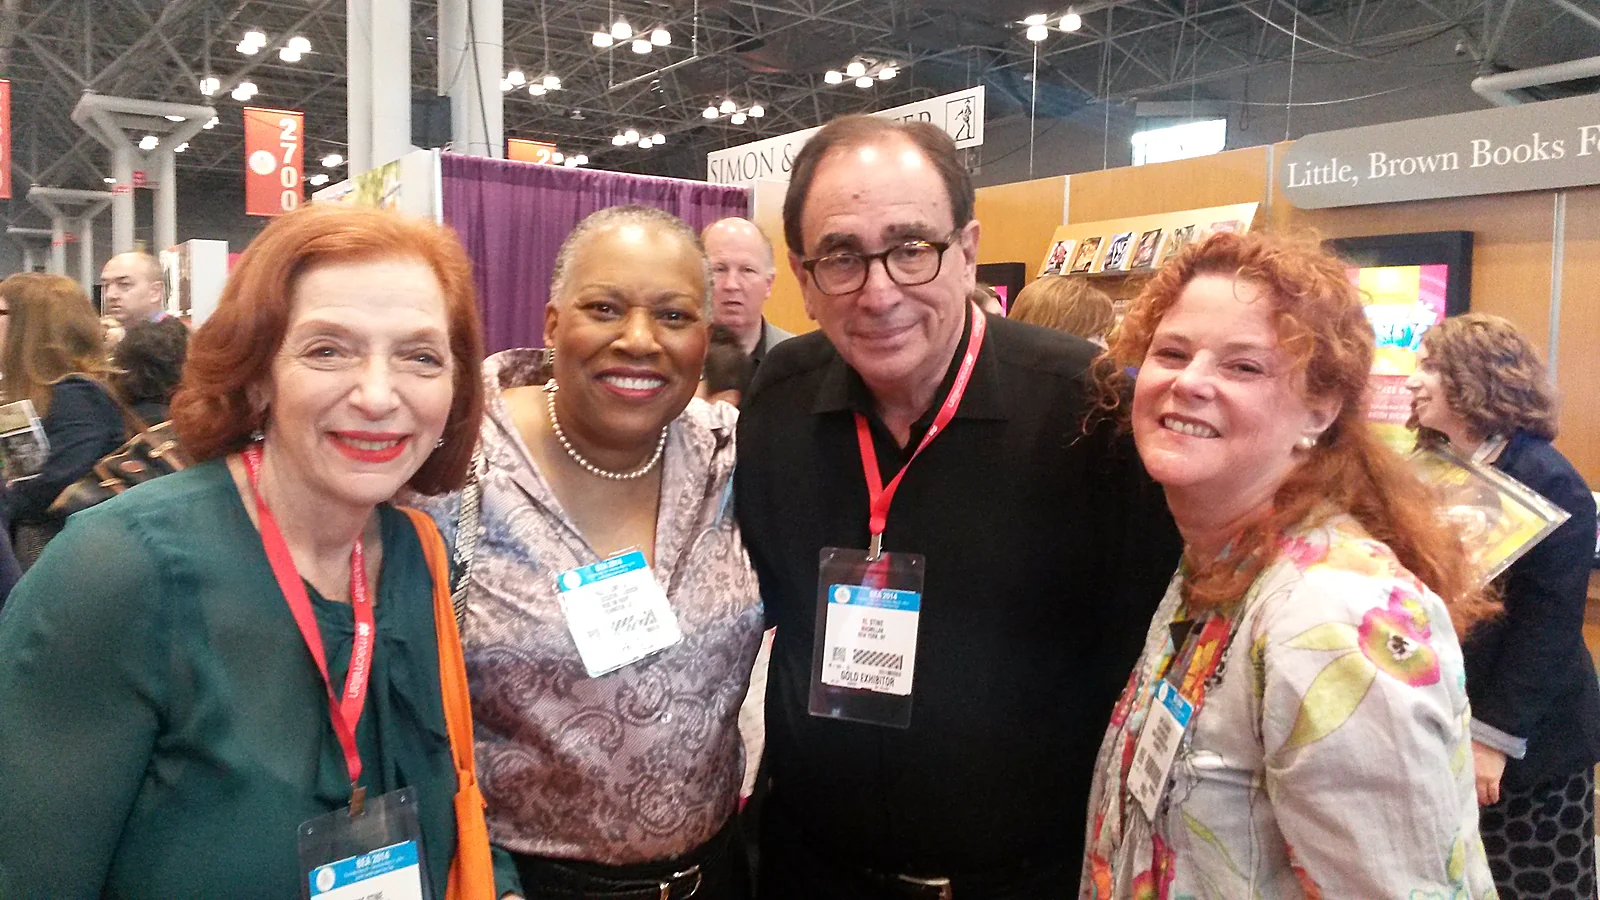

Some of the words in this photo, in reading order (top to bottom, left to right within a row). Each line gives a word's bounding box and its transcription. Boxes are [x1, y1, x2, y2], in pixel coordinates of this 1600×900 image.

[279, 118, 298, 211] 2700
[711, 147, 775, 184] SIMON
[781, 143, 796, 173] &
[1287, 158, 1359, 188] Little,
[1368, 151, 1460, 181] Brown
[1470, 132, 1565, 168] Books
[1576, 124, 1600, 156] F
[882, 591, 898, 600] 2014
[840, 670, 859, 682] GOLD
[860, 672, 895, 688] EXHIBITOR
